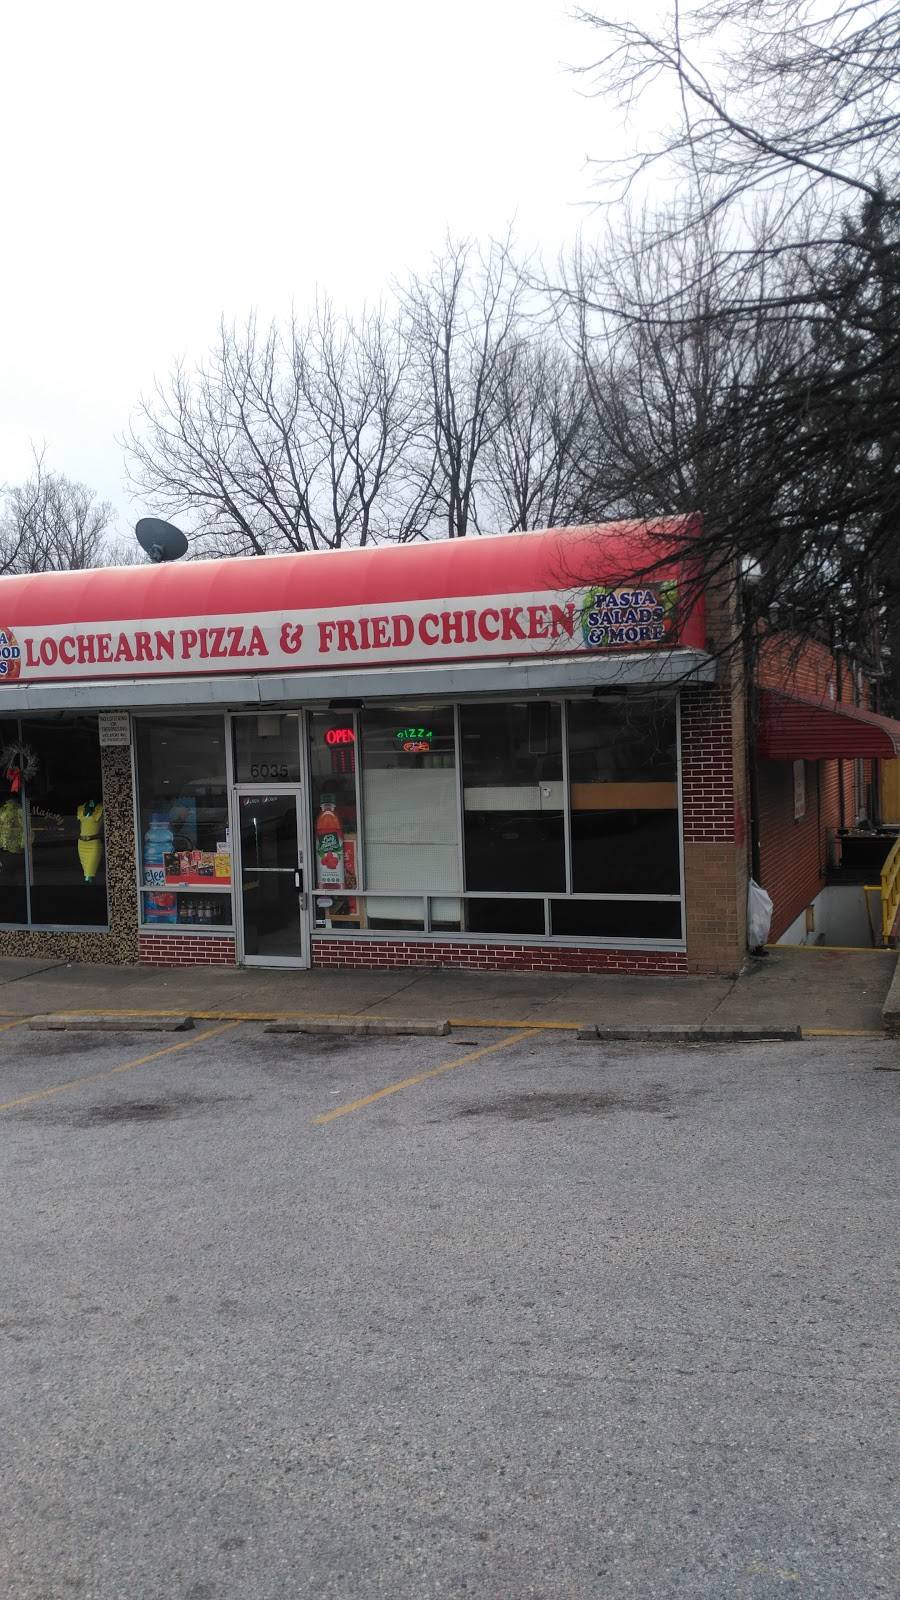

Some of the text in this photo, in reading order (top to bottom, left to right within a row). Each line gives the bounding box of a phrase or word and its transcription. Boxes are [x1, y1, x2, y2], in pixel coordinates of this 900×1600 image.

[594, 589, 657, 609] PASTA
[587, 606, 665, 627] SALADS
[25, 602, 577, 668] LOCHEARN PIZZA & FRIED CHICKEN
[587, 625, 665, 646] & MORE
[326, 729, 356, 744] OPEN
[250, 764, 288, 778] 6035
